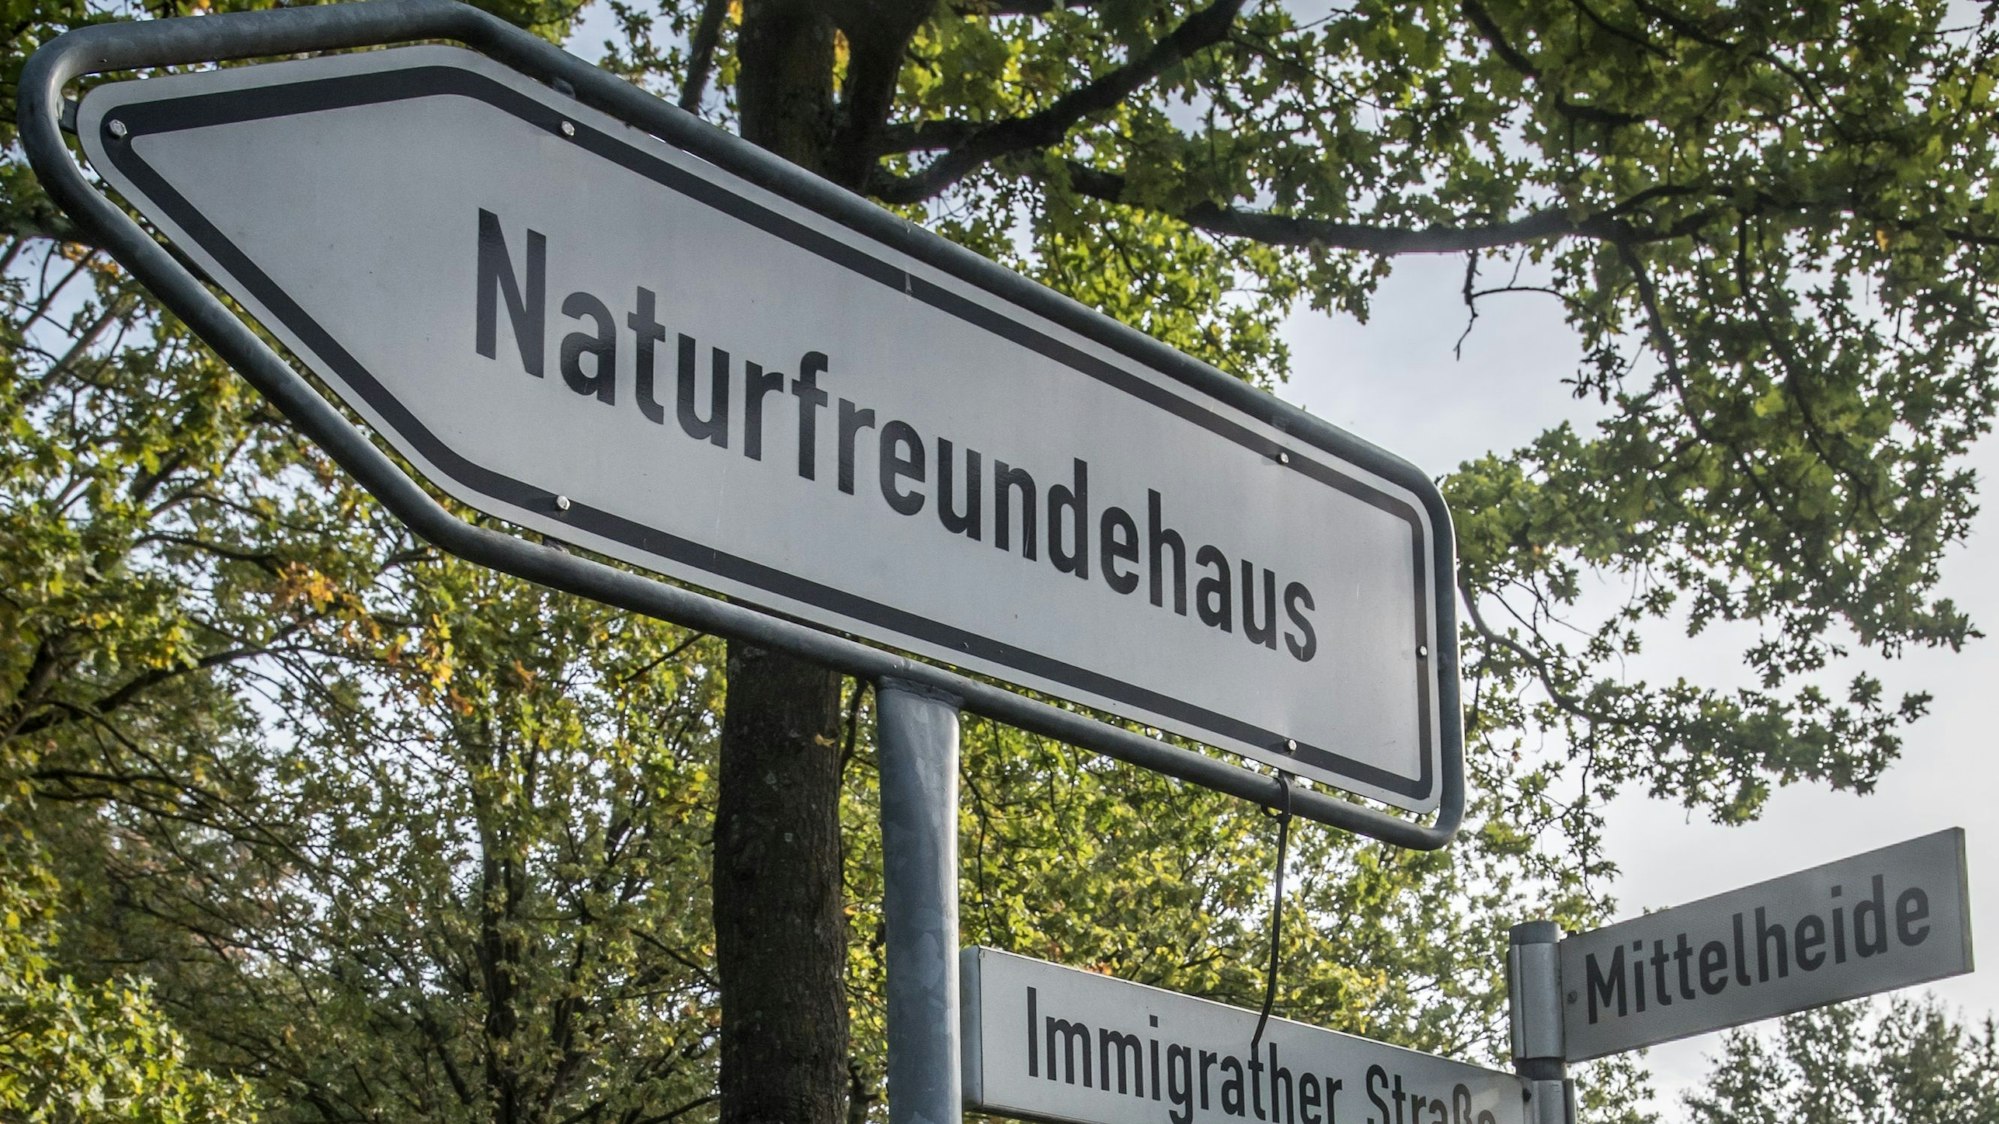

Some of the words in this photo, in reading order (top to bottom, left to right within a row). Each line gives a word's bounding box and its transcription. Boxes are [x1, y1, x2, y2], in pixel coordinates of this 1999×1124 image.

[476, 207, 1318, 663] Naturfreundehaus
[1585, 874, 1931, 1024] Mittelheide
[1026, 986, 1342, 1124] Immigrather
[1366, 1064, 1496, 1124] Straß
